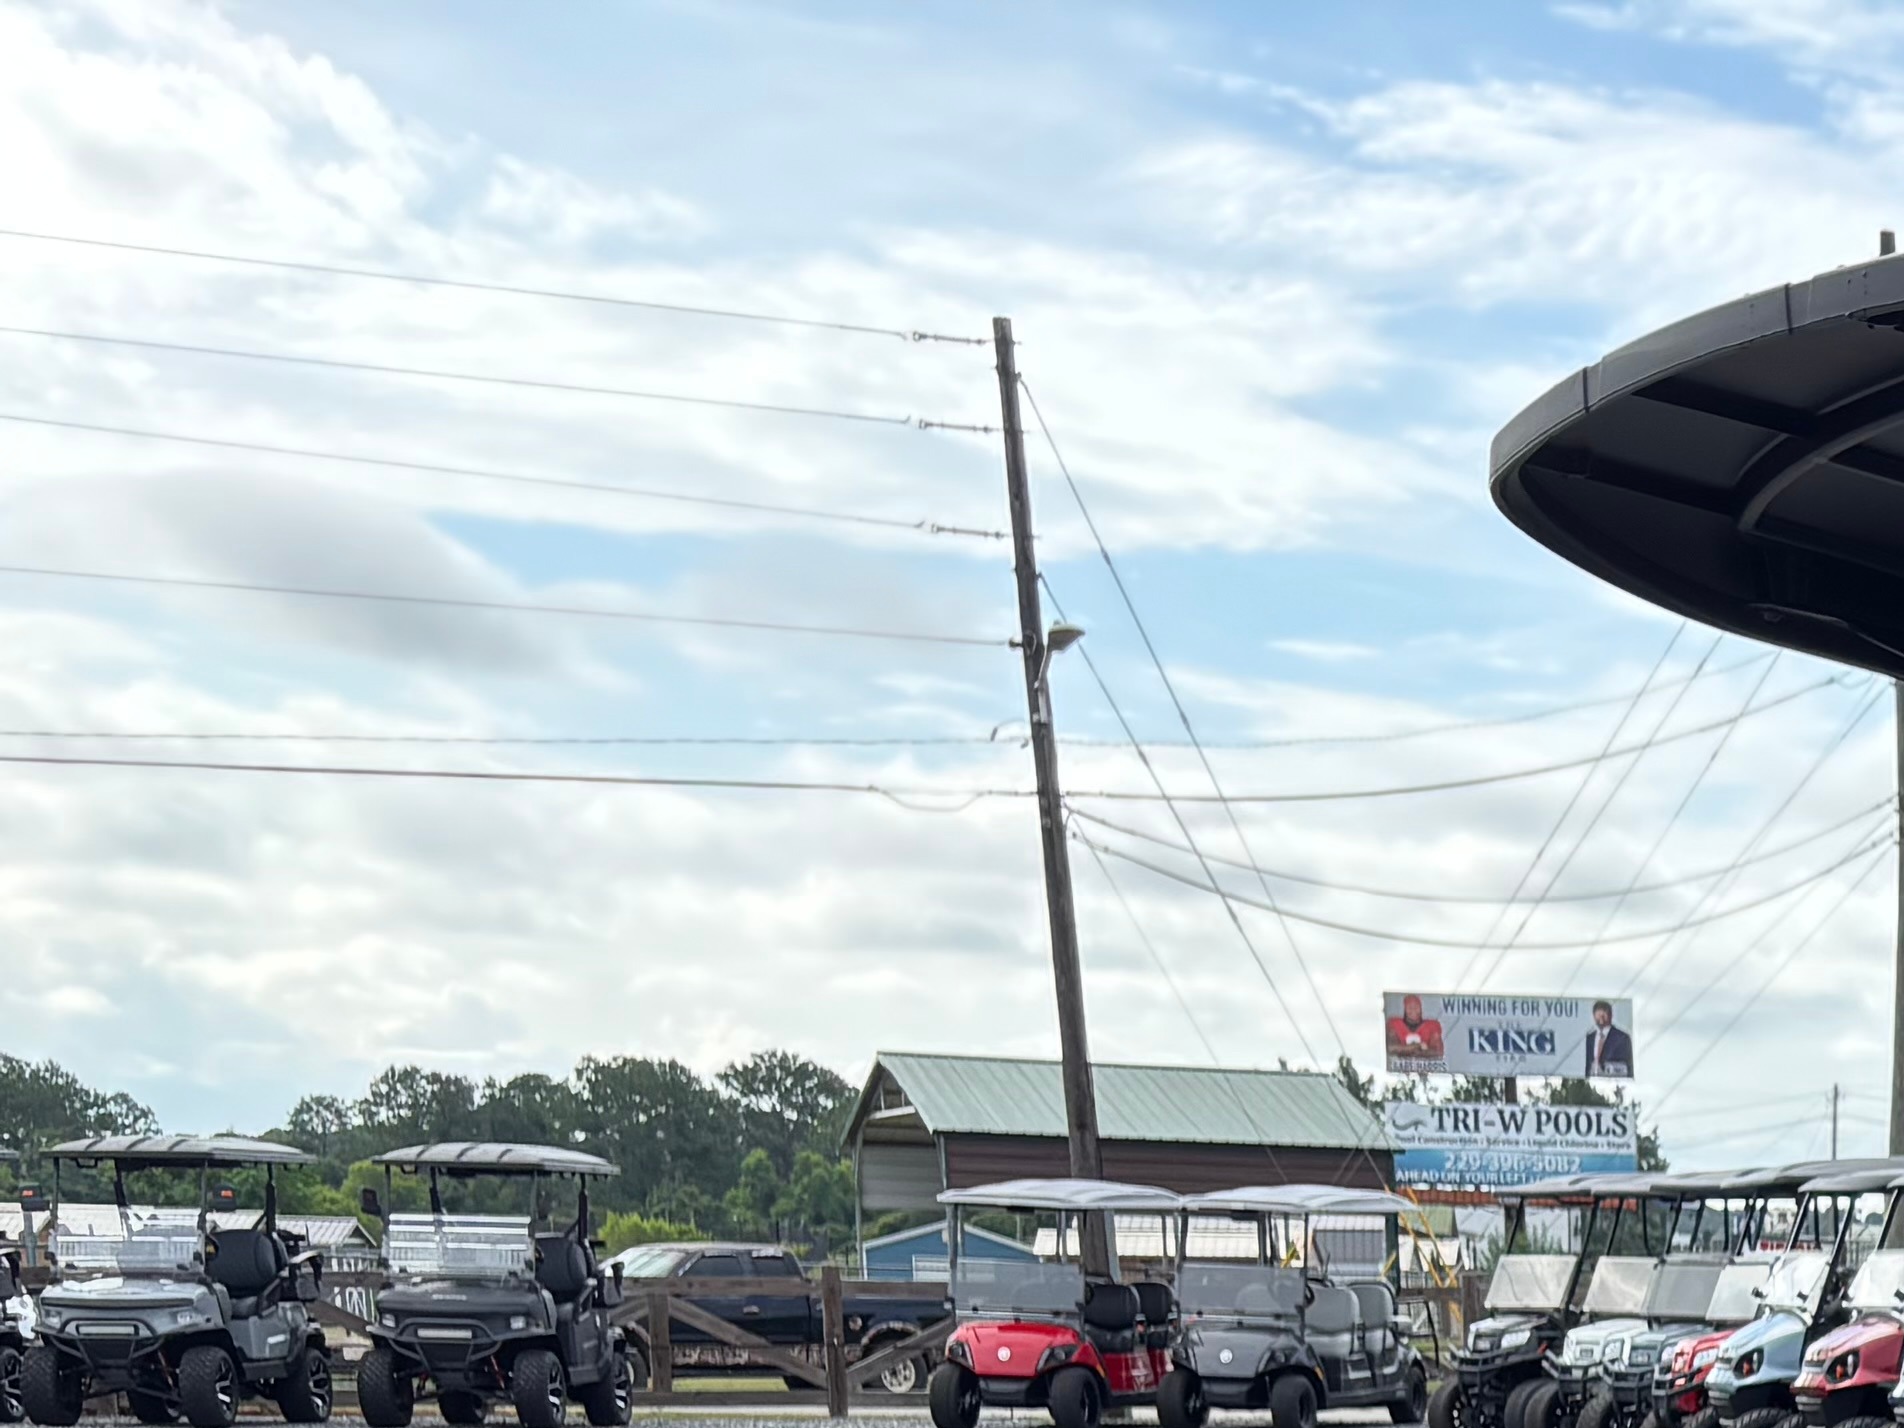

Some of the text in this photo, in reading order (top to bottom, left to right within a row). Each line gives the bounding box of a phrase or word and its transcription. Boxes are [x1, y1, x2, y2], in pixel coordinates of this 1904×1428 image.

[1442, 997, 1579, 1018] WINNING FOR YOU!
[1470, 1029, 1553, 1055] KING
[1430, 1107, 1627, 1137] TRI-W POOLS
[1396, 1169, 1438, 1184] AHEAD
[1464, 1172, 1497, 1185] YOUR
